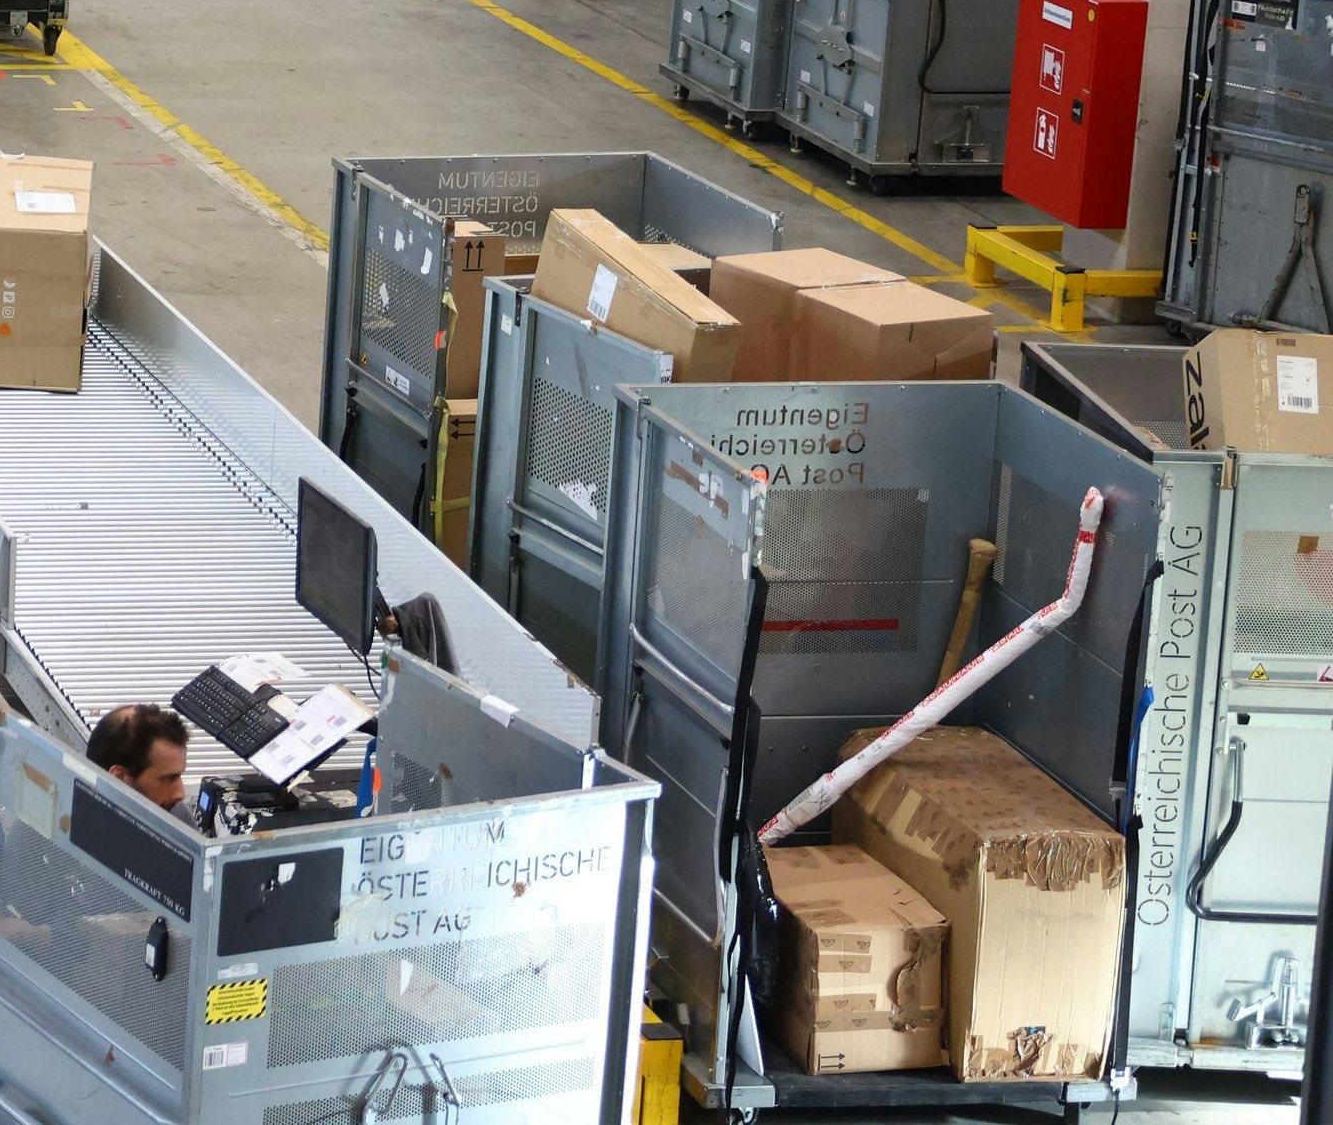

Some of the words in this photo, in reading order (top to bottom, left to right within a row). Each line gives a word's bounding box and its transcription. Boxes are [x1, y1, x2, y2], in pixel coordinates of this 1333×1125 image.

[1185, 351, 1210, 451] zal
[1159, 587, 1198, 660] Post
[359, 820, 506, 865] EIGNTUM
